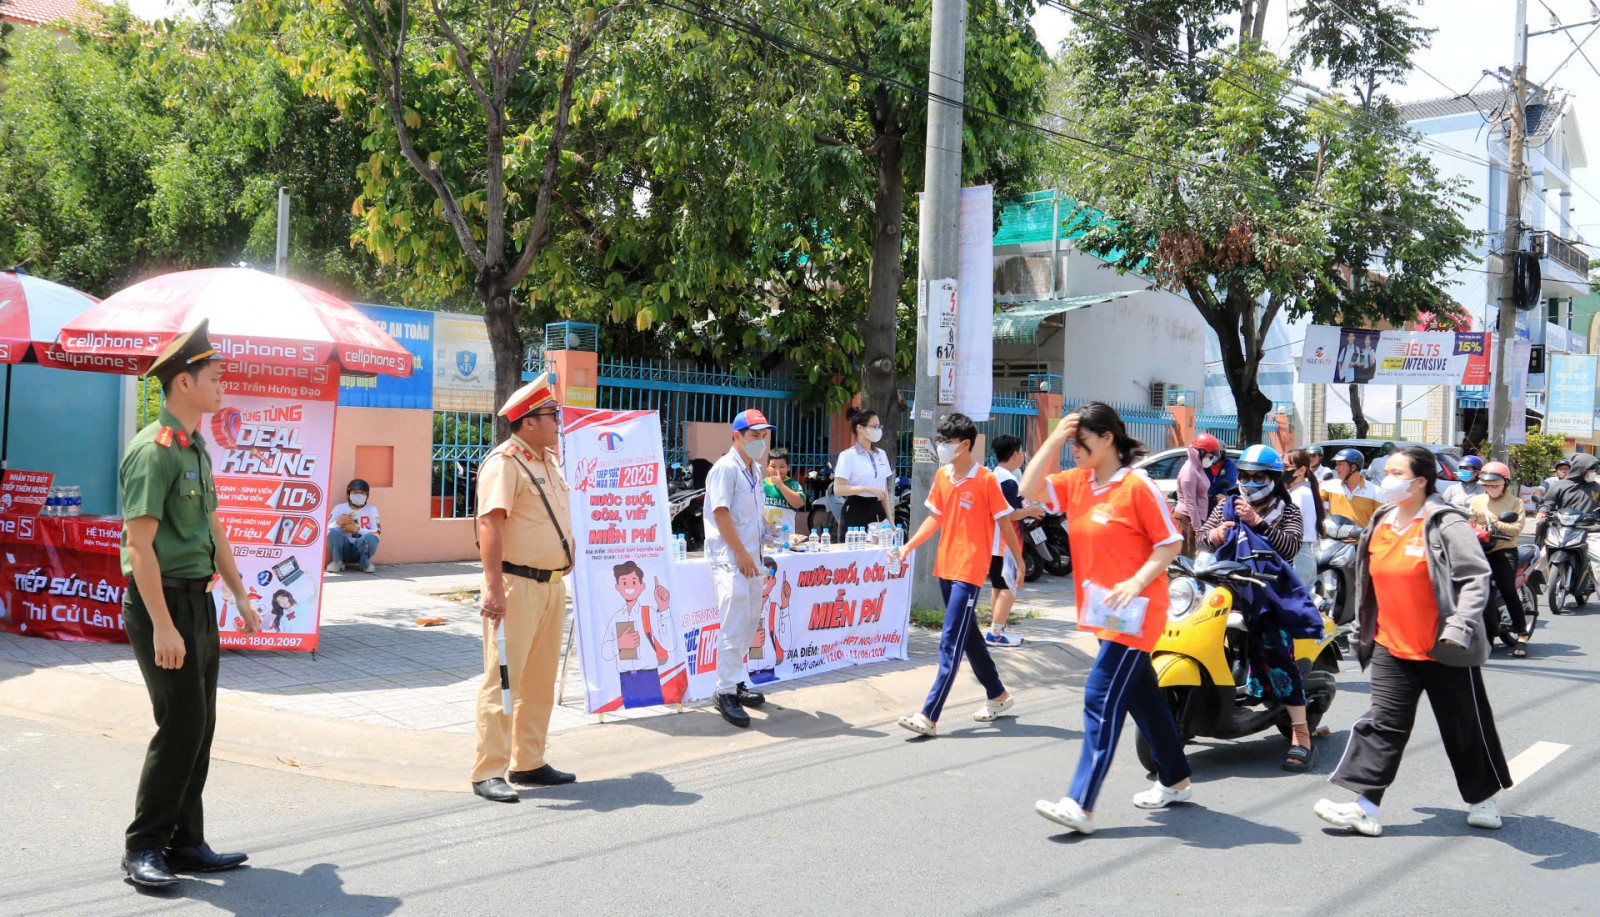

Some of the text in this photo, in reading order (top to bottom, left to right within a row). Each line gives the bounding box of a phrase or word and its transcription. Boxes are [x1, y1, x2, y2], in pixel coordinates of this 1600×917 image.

[388, 324, 402, 338] AN
[404, 322, 430, 340] TOÀN
[210, 340, 296, 360] ellphone
[1405, 343, 1441, 357] IELTS
[1458, 342, 1482, 352] 15%
[1402, 358, 1447, 370] INTENSIVE
[243, 382, 266, 392] Trần
[268, 384, 298, 397] Hưng
[300, 386, 320, 397] Đạo
[242, 404, 304, 422] TÙNG TÙNG
[236, 424, 304, 450] DEAL
[220, 448, 318, 477] KHỦNG
[622, 464, 654, 486] 2026
[282, 488, 316, 506] 10%
[590, 490, 655, 506] NƯỚC SUỐI,
[626, 505, 648, 520] VIẾT
[86, 526, 122, 538] HỆ THỐN
[234, 528, 262, 541] Triệu
[588, 523, 658, 544] MIỄN PHÍ
[798, 564, 832, 587] NƯỚC
[14, 568, 48, 592] TIẾP
[48, 574, 88, 598] SỨC
[89, 579, 120, 604] LÊN
[858, 588, 887, 626] PHÍ
[52, 604, 80, 622] Cử
[83, 608, 114, 630] Lên
[220, 636, 303, 647] HÀNG 1800.2097
